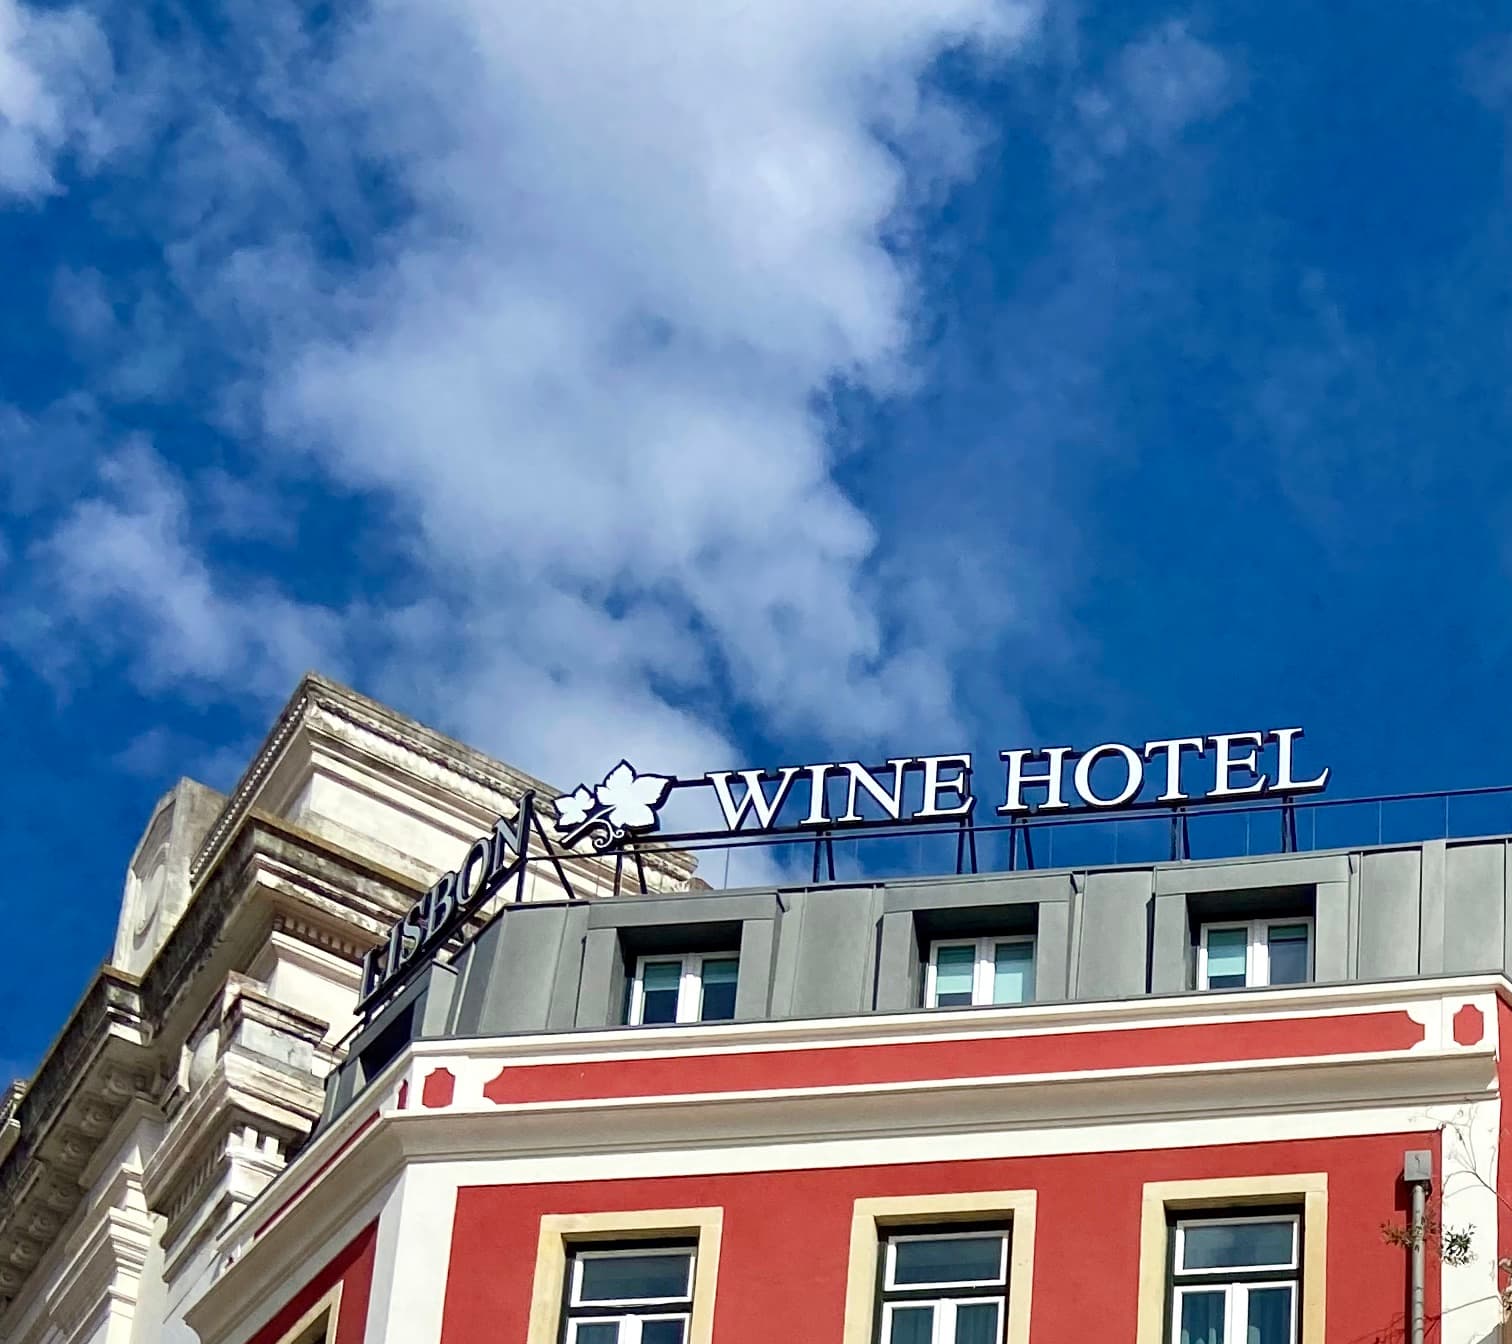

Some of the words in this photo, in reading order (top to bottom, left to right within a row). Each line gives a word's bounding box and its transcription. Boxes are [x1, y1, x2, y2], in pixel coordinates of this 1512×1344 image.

[704, 752, 975, 831] WINE
[996, 727, 1330, 816] HOTEL
[359, 790, 535, 1006] LISBON
